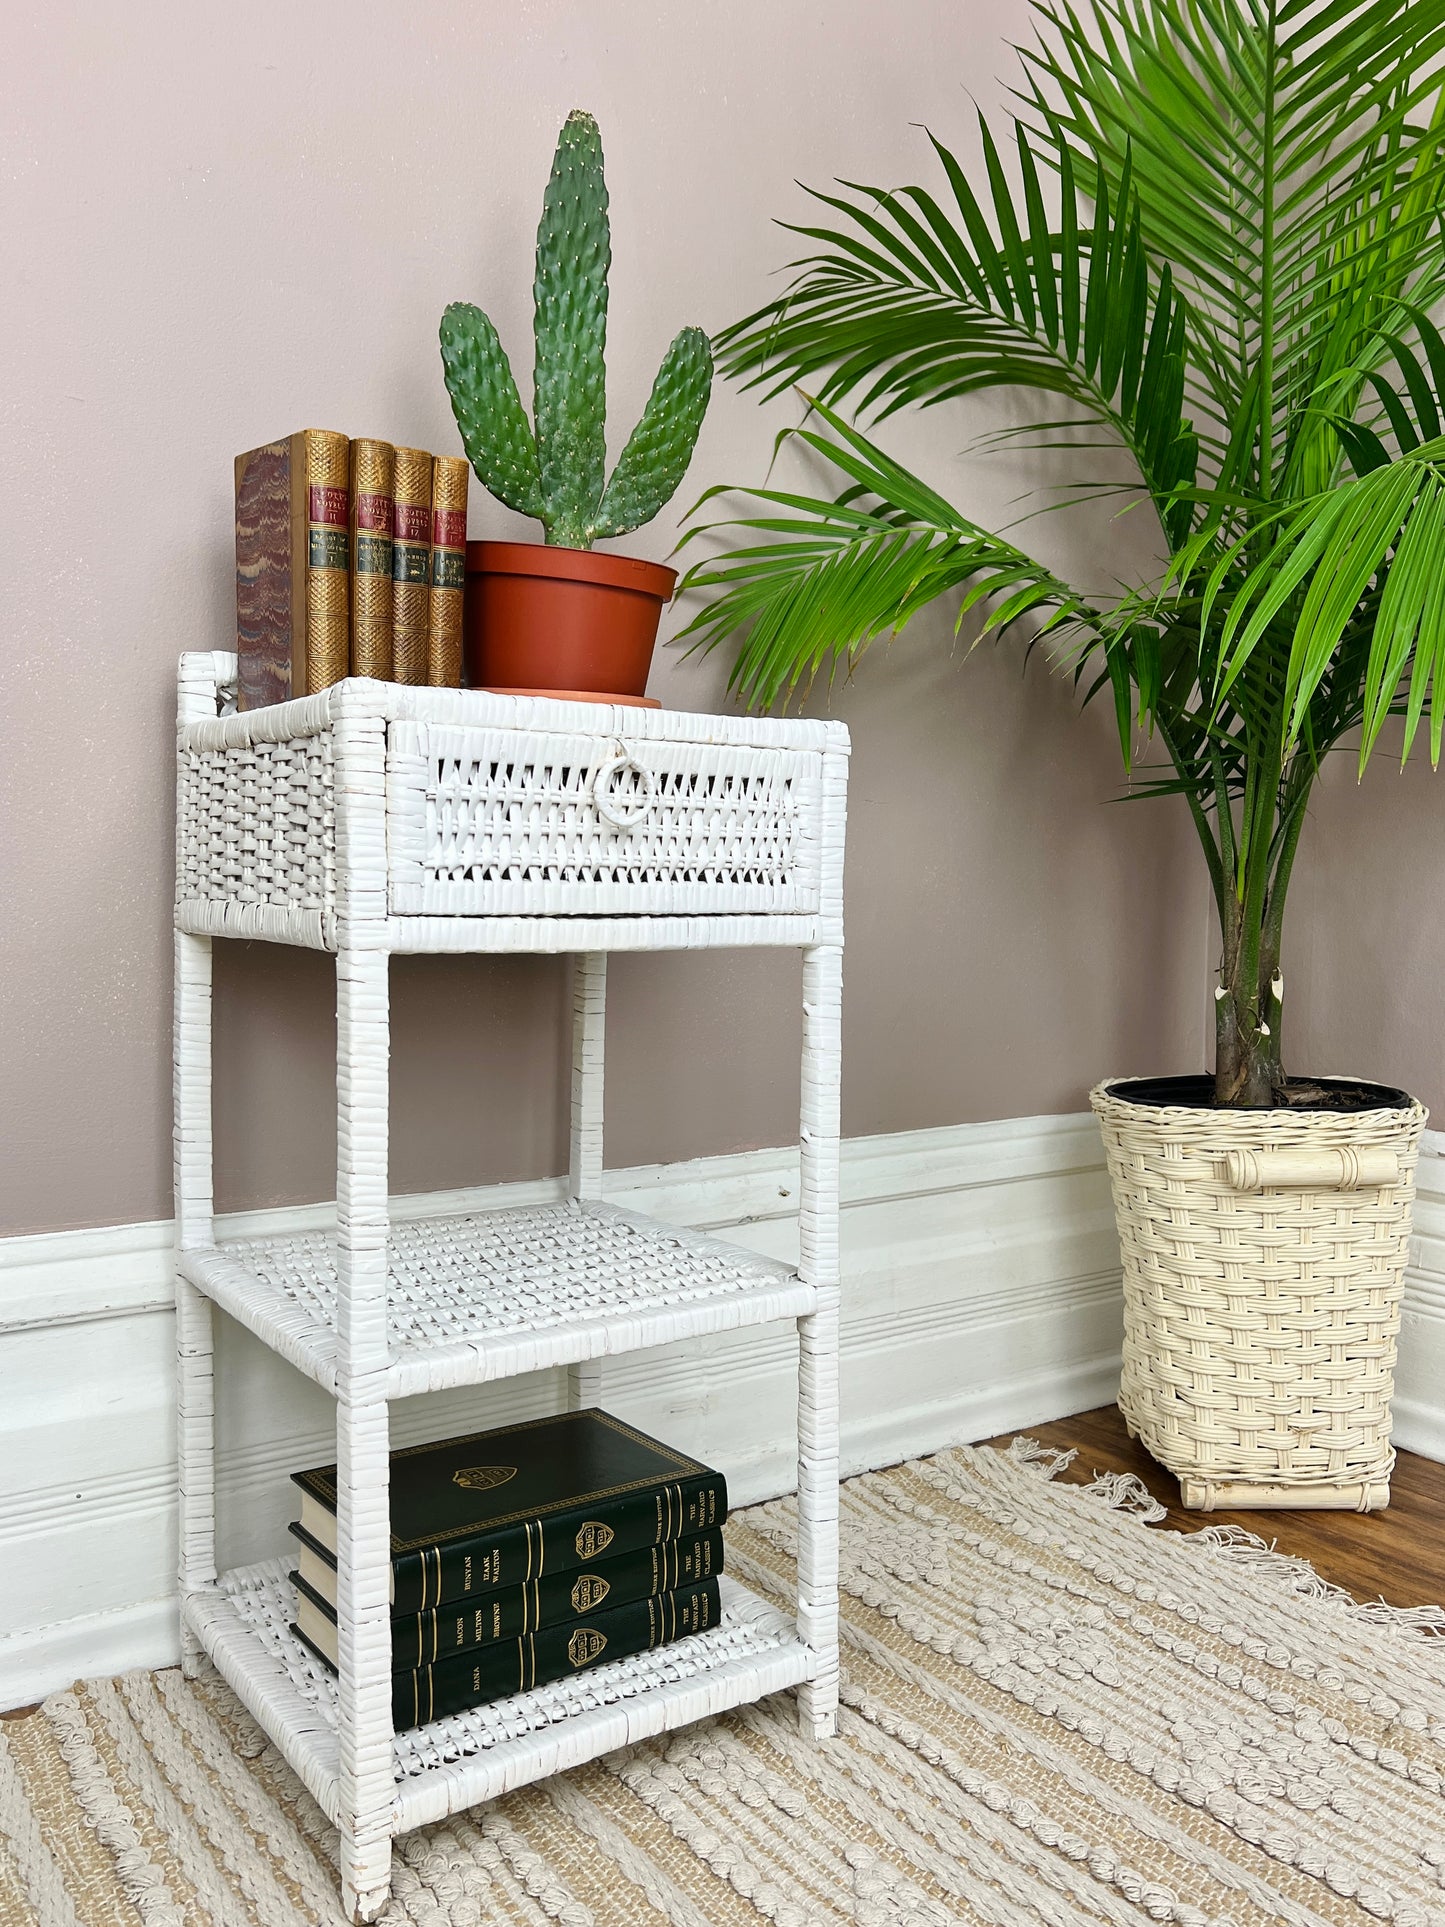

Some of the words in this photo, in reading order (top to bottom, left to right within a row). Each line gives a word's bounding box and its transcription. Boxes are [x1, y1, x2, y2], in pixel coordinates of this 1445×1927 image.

[316, 499, 346, 510] NOVELS
[464, 1556, 472, 1590] BUNYAN
[492, 1549, 500, 1583] WALTON
